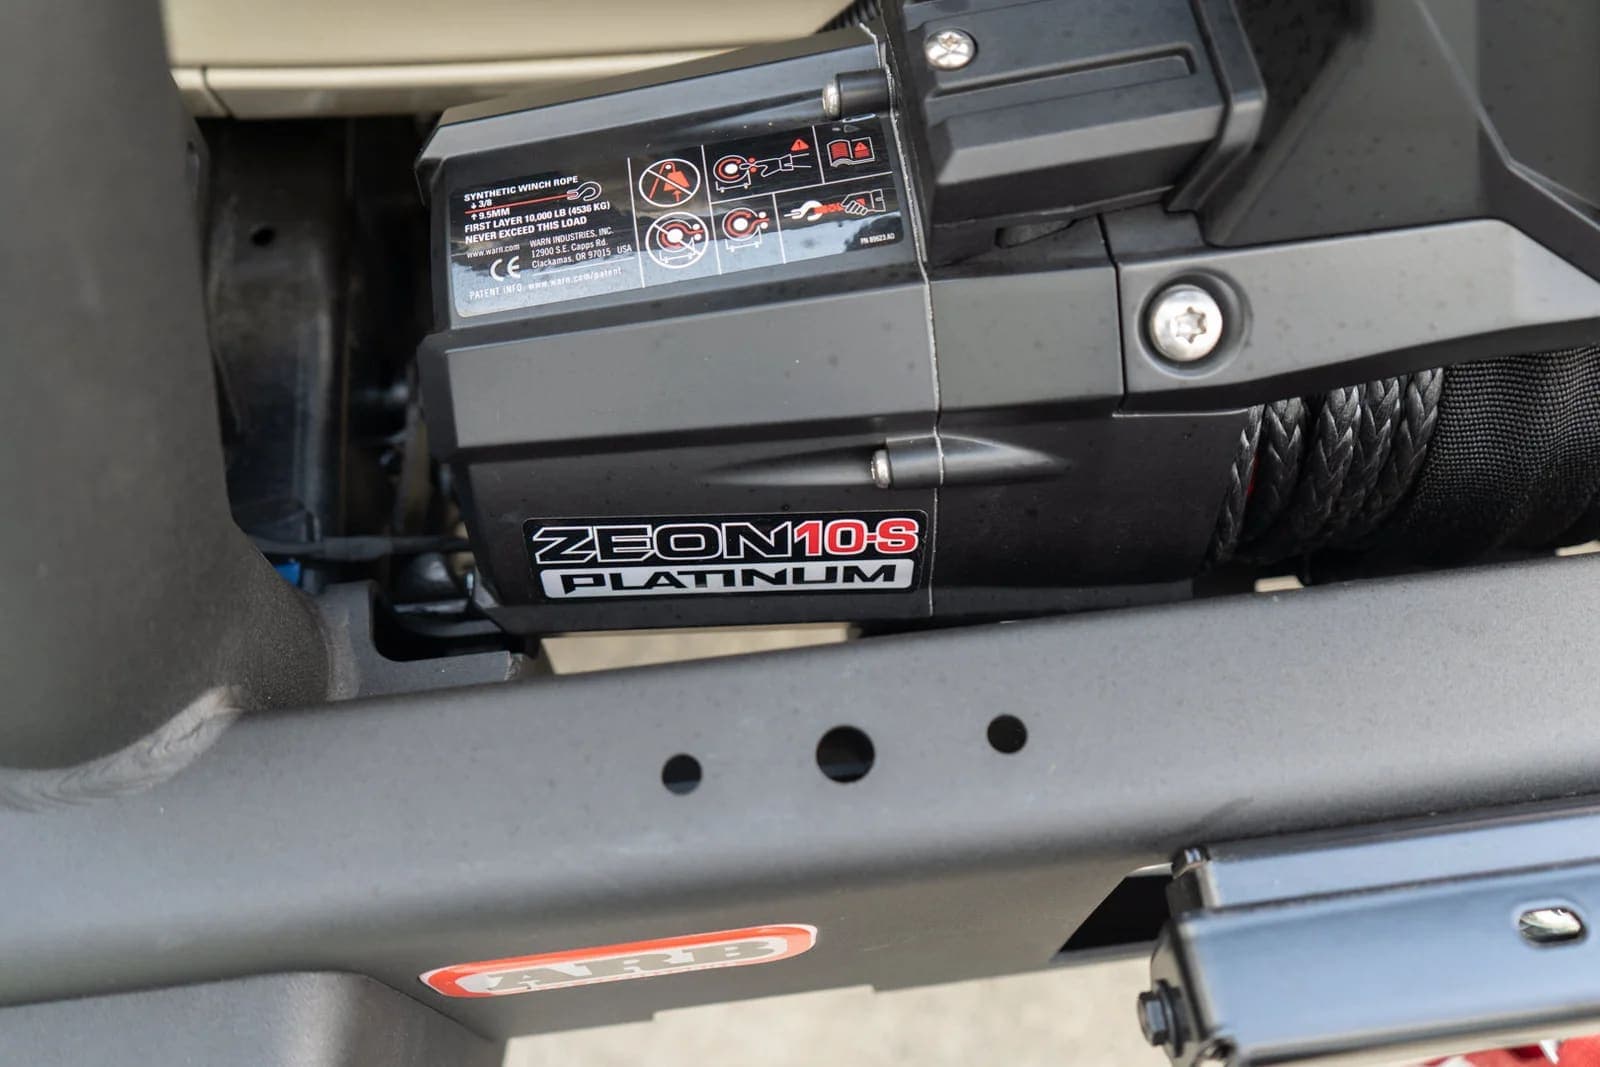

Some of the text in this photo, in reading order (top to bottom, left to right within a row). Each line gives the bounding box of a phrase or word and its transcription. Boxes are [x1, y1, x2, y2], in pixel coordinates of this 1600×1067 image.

[464, 176, 579, 201] SYNTHETIC WINCH ROPE
[478, 199, 493, 208] 3/8
[478, 208, 511, 220] 9.5MM
[464, 200, 611, 233] FIRST LAYER 10,000 LB (4536 KG)
[465, 216, 588, 244] NEVER EXCEED THIS LOAD
[529, 236, 552, 248] WARN
[599, 226, 614, 237] INC.
[466, 243, 521, 259] www.warn.com
[531, 236, 609, 259] 12900 S.E. Capps Rd.
[575, 252, 588, 262] OR
[588, 248, 612, 260] 97015
[616, 244, 633, 255] USA
[469, 288, 501, 301] PATENT
[528, 267, 622, 290] www.warn.com/patent
[559, 564, 898, 595] PLATINUM
[486, 940, 779, 991] ARB
